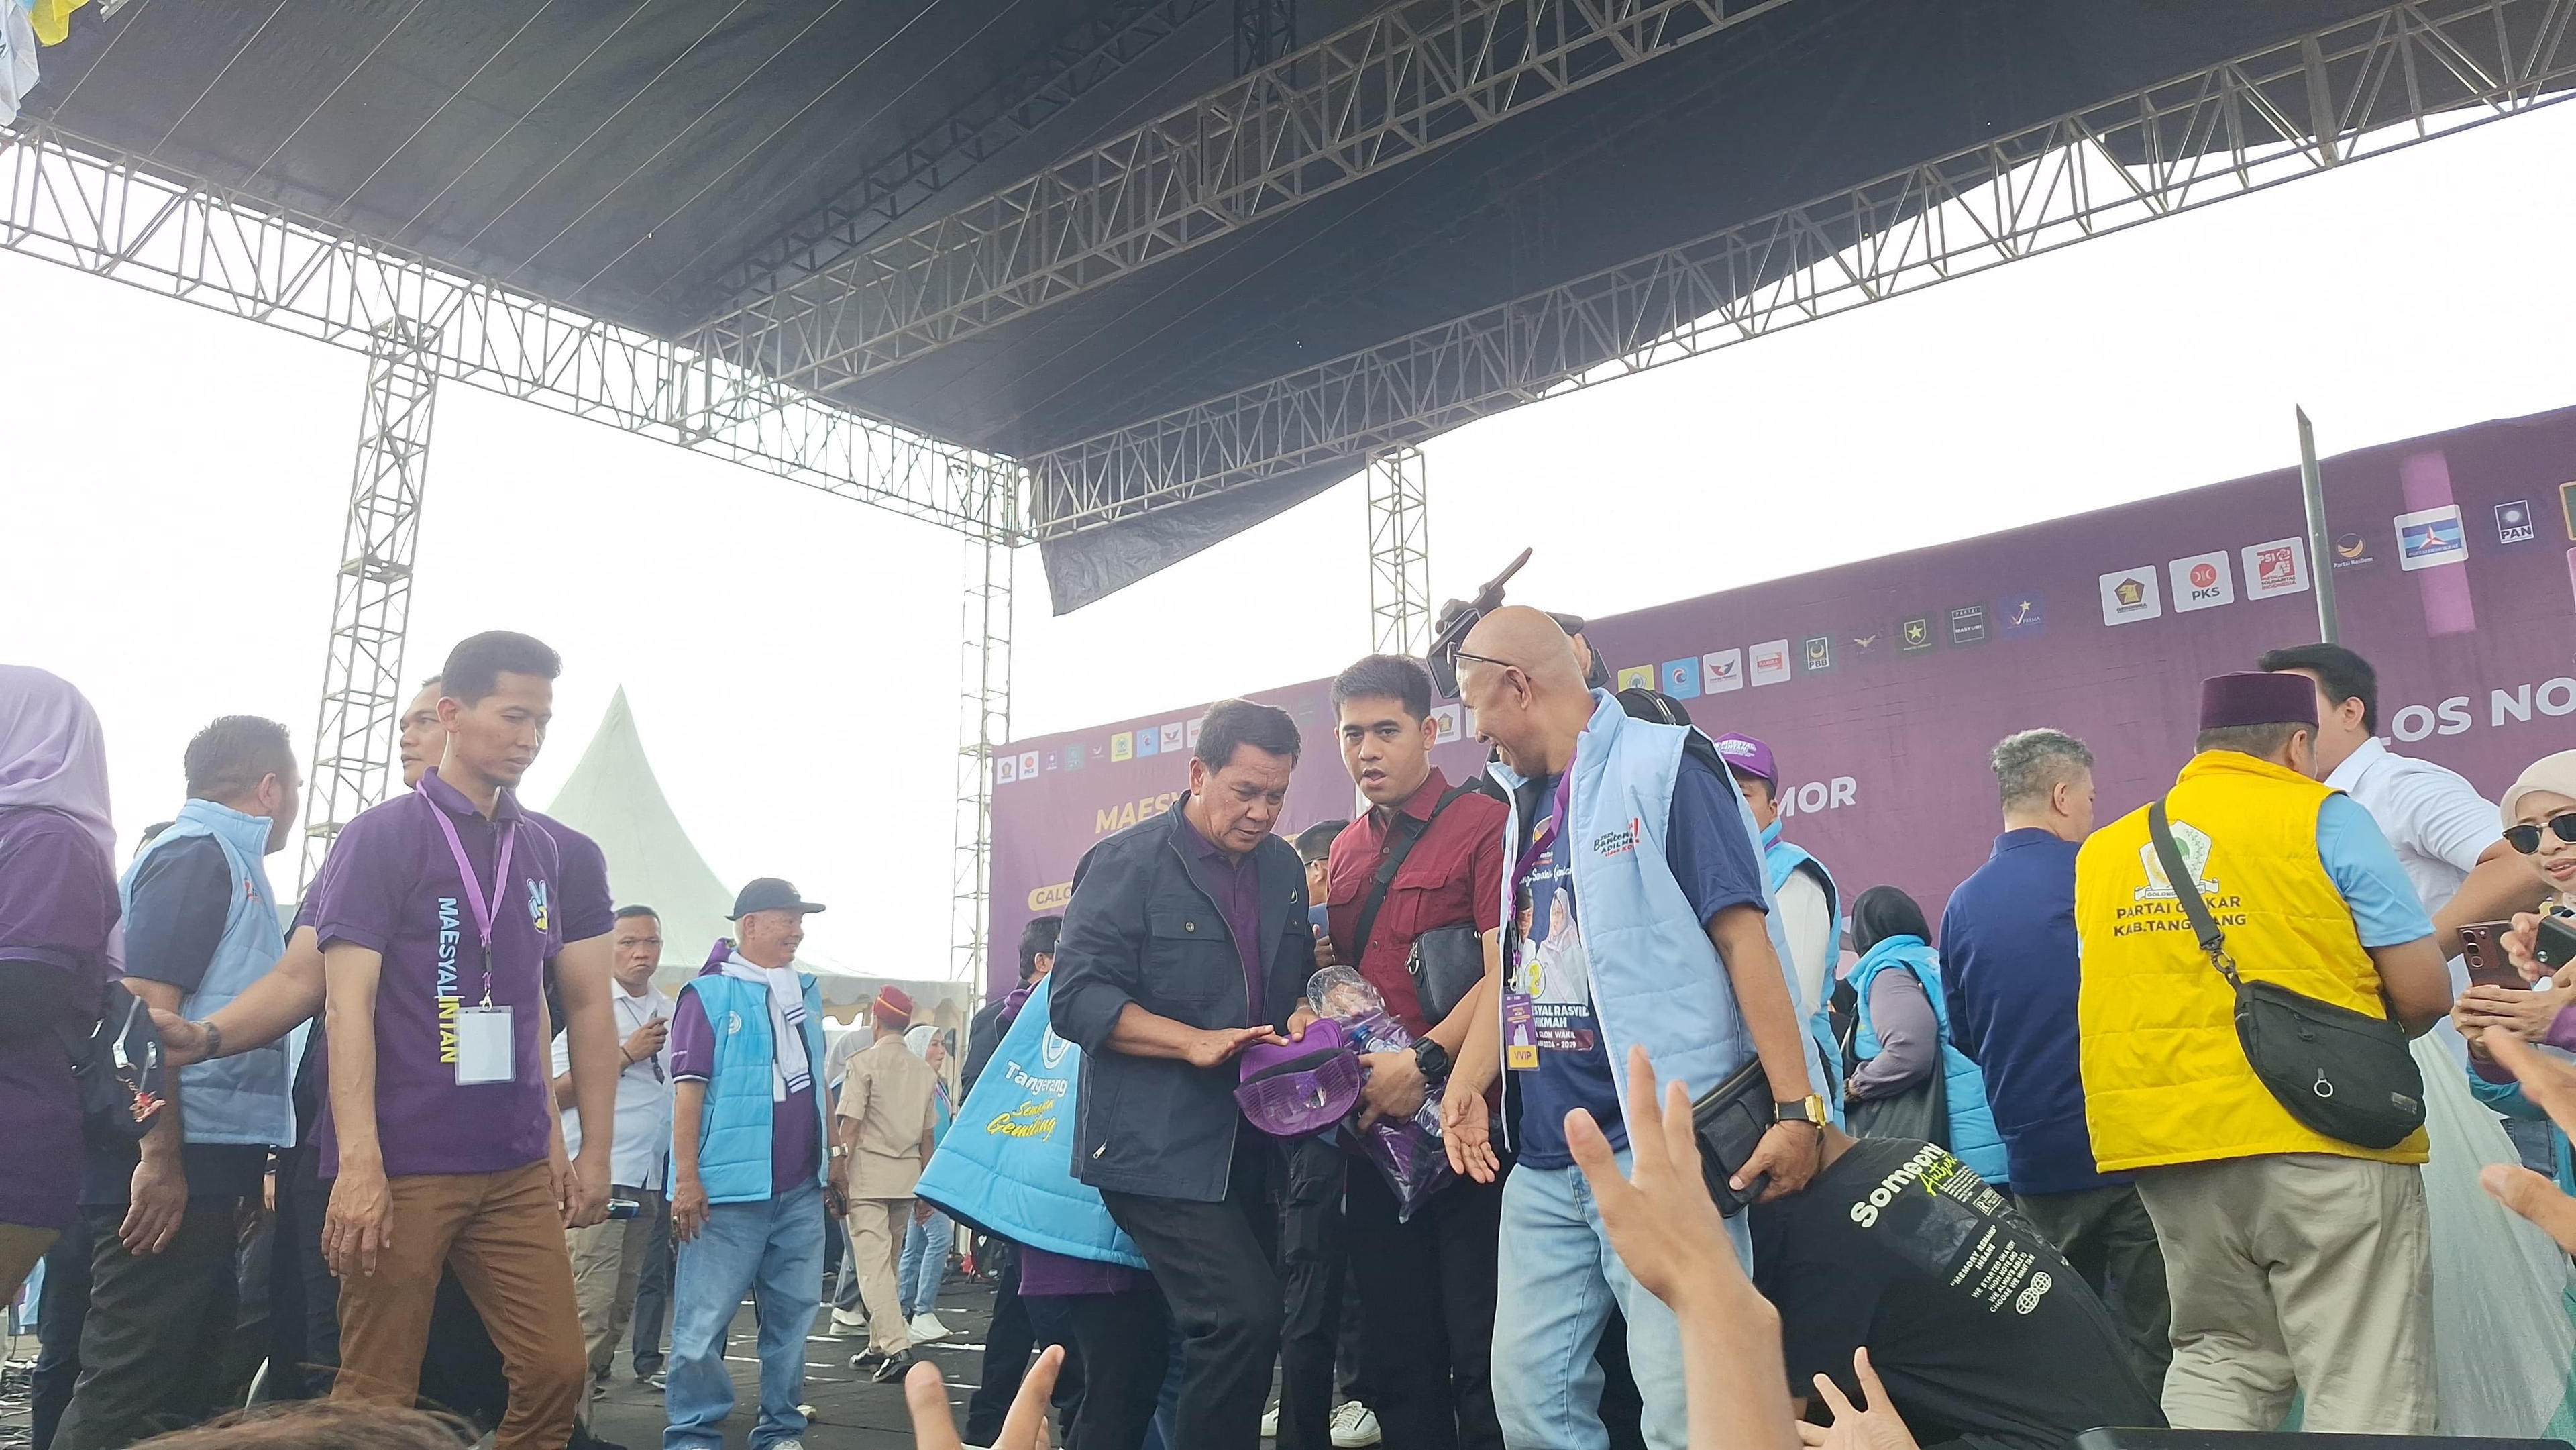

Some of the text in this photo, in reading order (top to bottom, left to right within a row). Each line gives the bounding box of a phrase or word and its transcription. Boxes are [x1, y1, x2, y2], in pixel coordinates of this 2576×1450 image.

[2501, 526, 2532, 539] PAN
[2257, 553, 2275, 564] PSI
[2192, 586, 2220, 601] PKS
[1809, 659, 1828, 669] PBB
[1778, 776, 1857, 817] MOR
[1095, 792, 1181, 834] MAES
[1601, 842, 1621, 854] ADIL
[1035, 886, 1071, 905] CALO
[2116, 895, 2241, 920] PARTAI GKAR
[2112, 913, 2247, 937] KAB.TANGANG
[437, 897, 460, 997] MAESYAL
[1529, 963, 1540, 995] 2
[438, 997, 460, 1064] INTAN
[1554, 1030, 1576, 1039] WAKIL
[1513, 1050, 1532, 1061] VVIP
[1561, 1041, 1576, 1049] 2029
[1005, 1059, 1068, 1098] Tangerang
[986, 1113, 1057, 1143] Gemilang
[1970, 1286, 1984, 1298] WE
[1980, 1260, 2002, 1288] STARTED
[1988, 1290, 2000, 1302] WE
[1996, 1268, 2017, 1294] ALWAYS
[1989, 1286, 2014, 1313] CHOOSE
